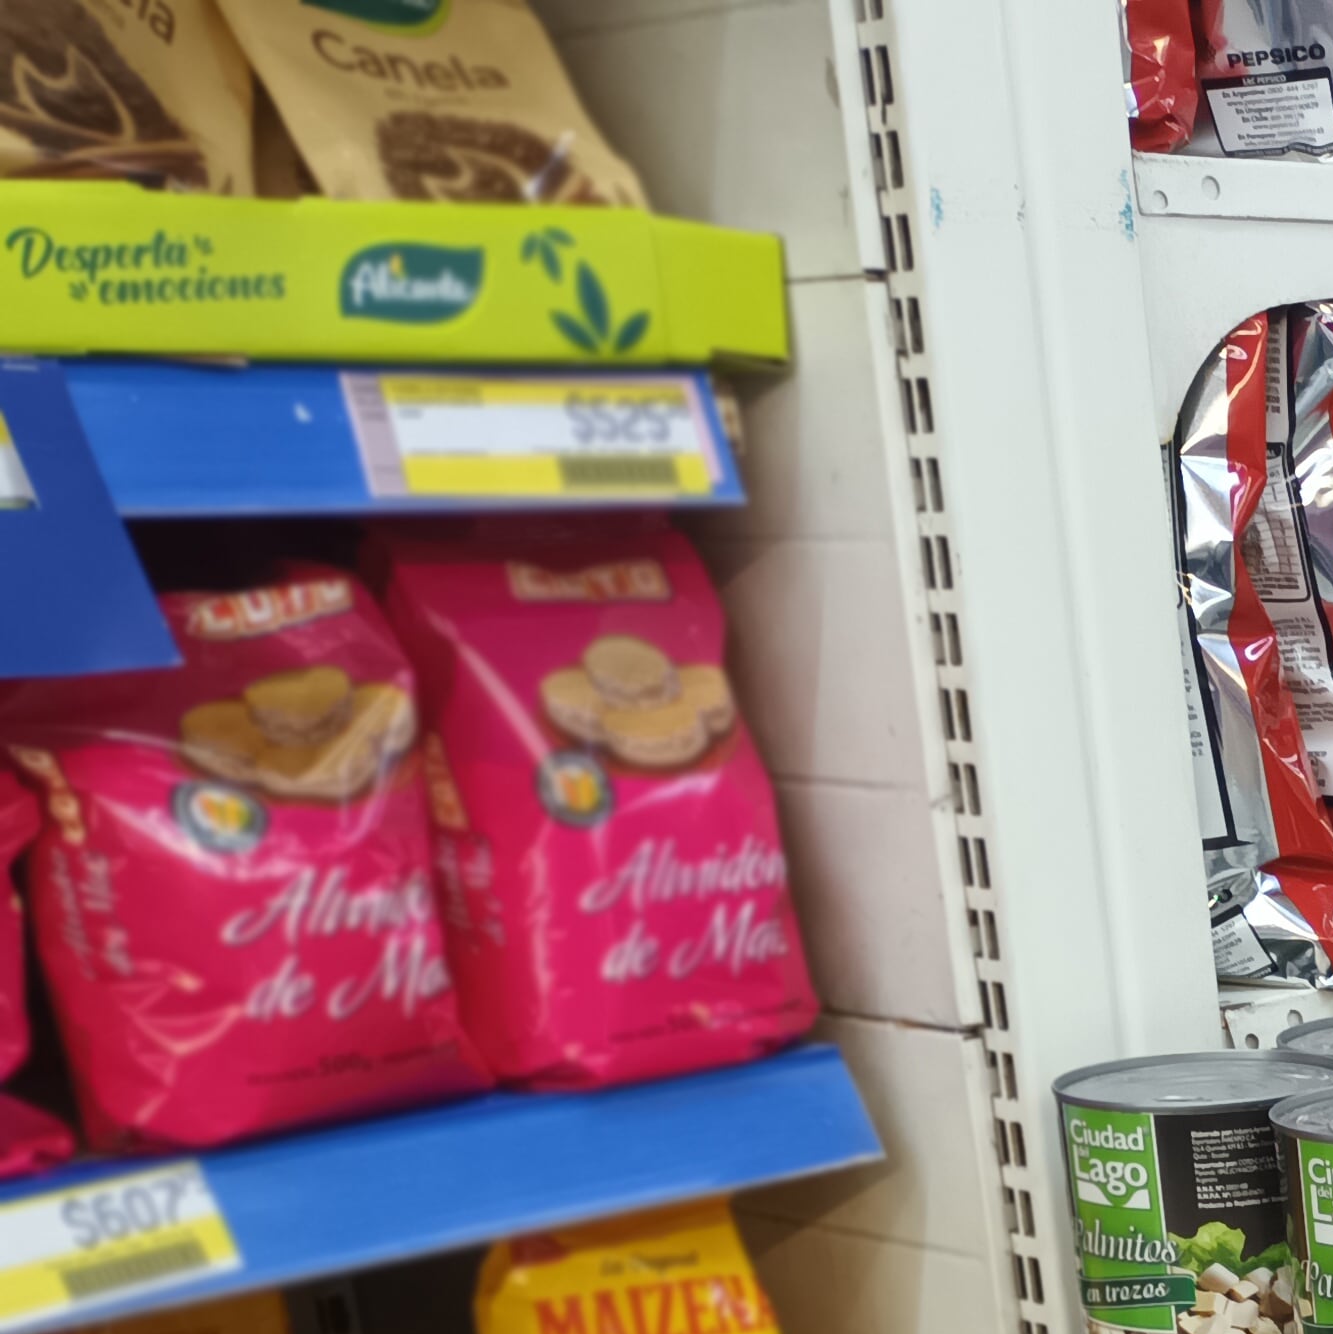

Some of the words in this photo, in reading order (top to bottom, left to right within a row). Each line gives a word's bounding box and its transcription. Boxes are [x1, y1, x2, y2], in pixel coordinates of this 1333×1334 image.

[311, 28, 509, 95] Canela
[1227, 44, 1325, 68] PEPSICO
[5, 226, 188, 283] Desperta
[98, 267, 287, 305] emociones
[328, 936, 451, 1018] Ma
[1070, 1118, 1145, 1153] Ciudad
[1078, 1146, 1090, 1156] del
[1074, 1148, 1149, 1196] Lago
[1317, 1186, 1333, 1199] del
[1076, 1215, 1179, 1264] Palmitos
[1086, 1285, 1102, 1303] en
[1106, 1281, 1169, 1303] trozos
